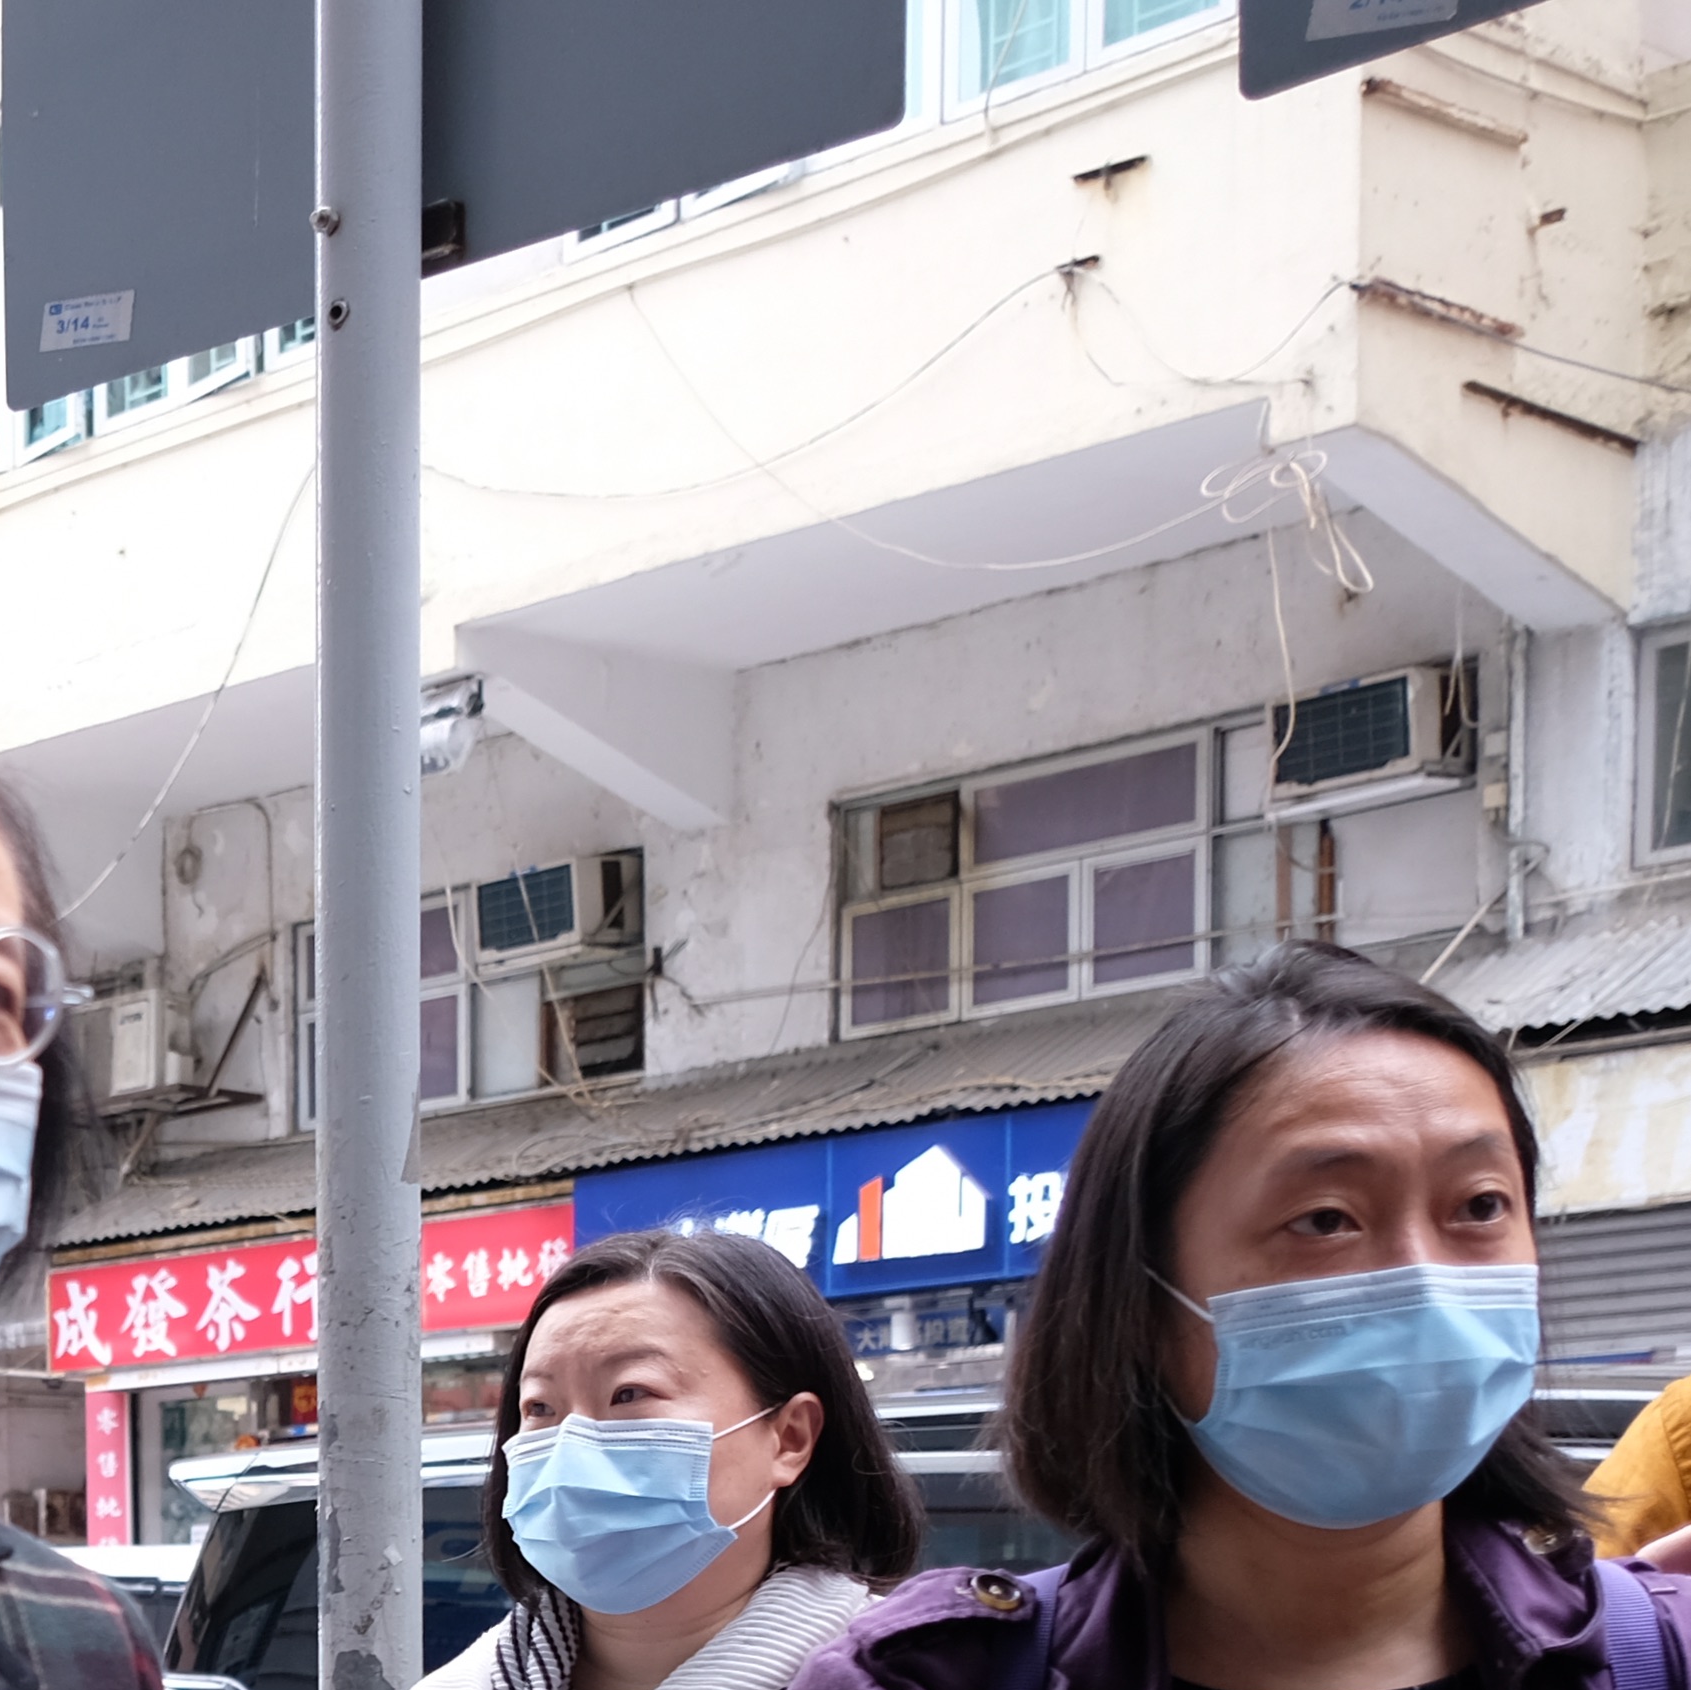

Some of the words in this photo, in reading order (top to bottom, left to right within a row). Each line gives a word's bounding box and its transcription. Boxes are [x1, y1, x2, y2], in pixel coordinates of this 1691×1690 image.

[56, 315, 90, 334] 3/14
[52, 1250, 318, 1367] 成發茶行
[94, 1405, 123, 1546] 零售批
